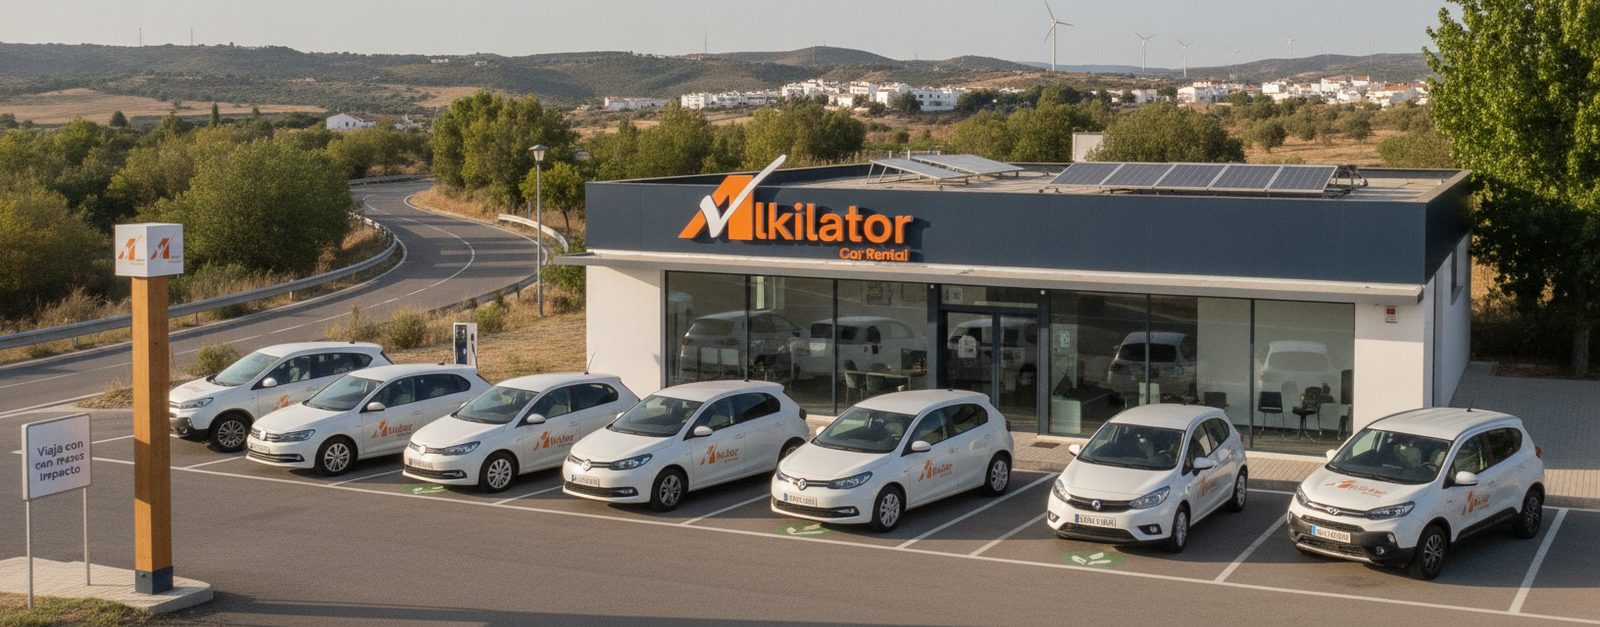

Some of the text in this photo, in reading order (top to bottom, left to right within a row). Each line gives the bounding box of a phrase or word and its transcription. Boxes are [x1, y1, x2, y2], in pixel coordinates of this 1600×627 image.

[678, 172, 913, 244] Alkilator
[839, 247, 864, 260] Car
[37, 440, 84, 457] Viaja con
